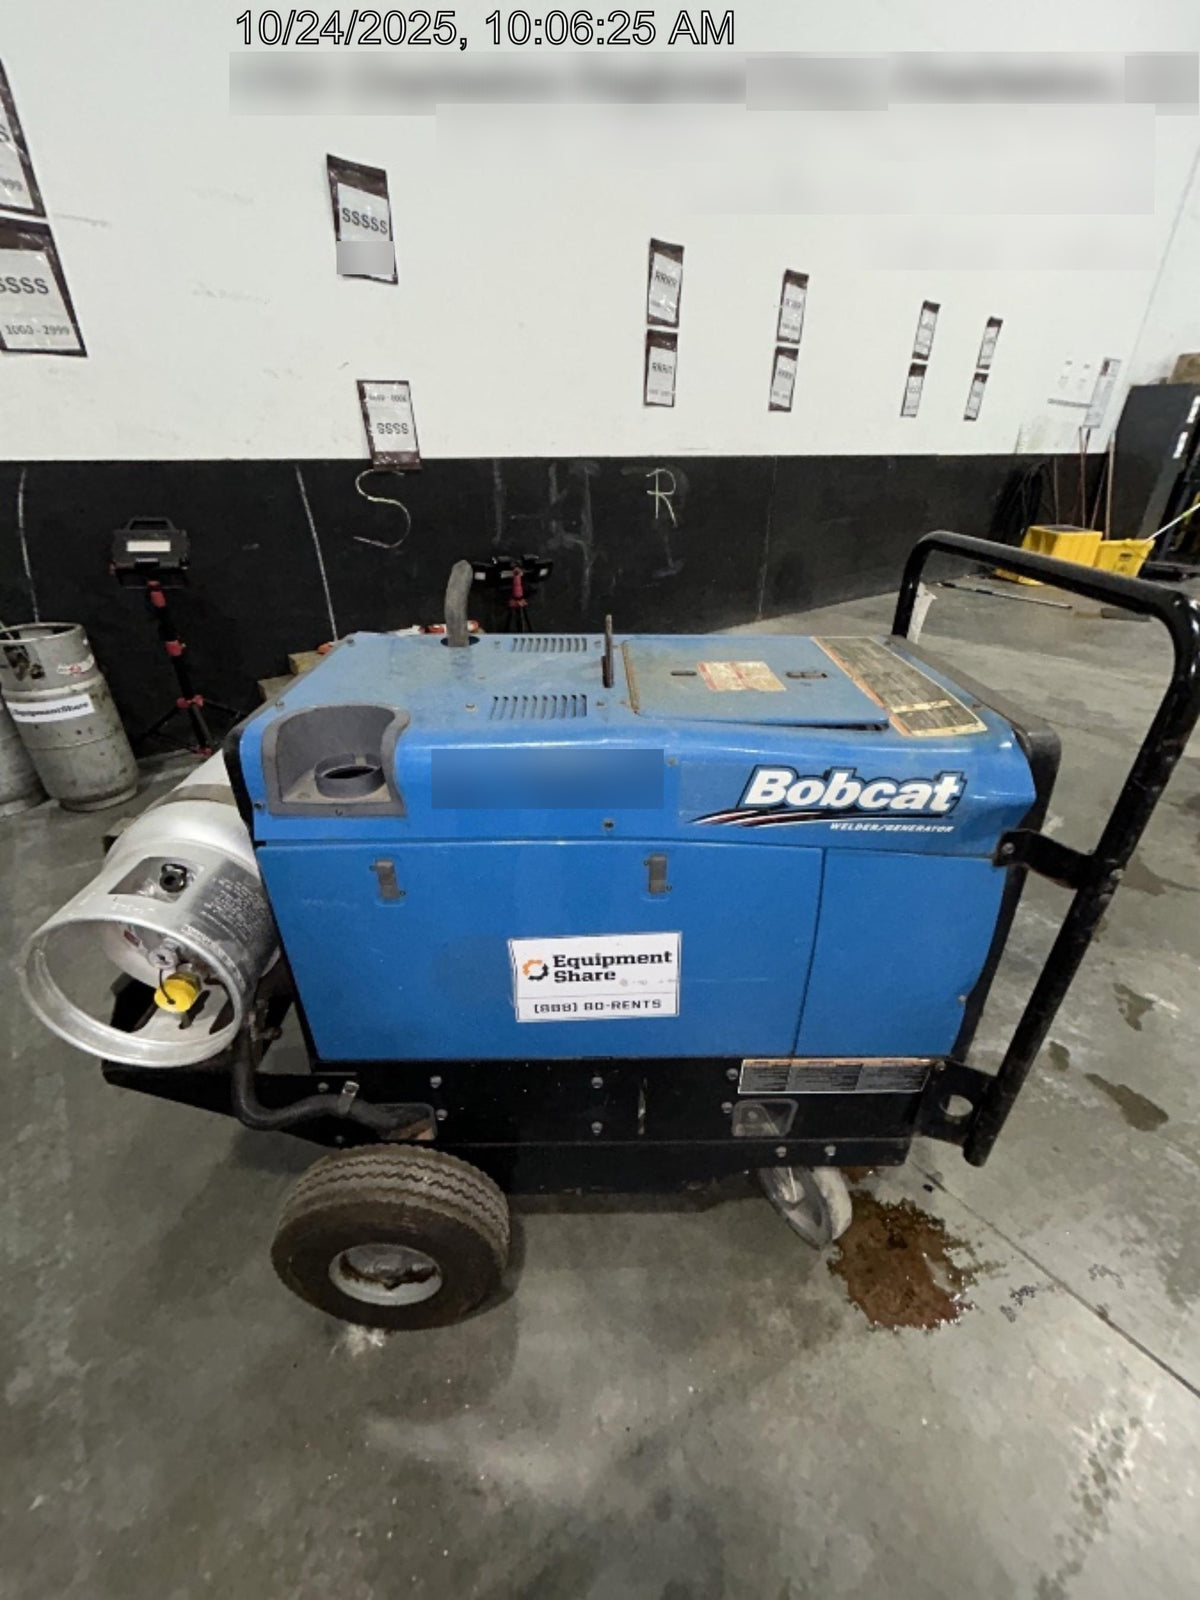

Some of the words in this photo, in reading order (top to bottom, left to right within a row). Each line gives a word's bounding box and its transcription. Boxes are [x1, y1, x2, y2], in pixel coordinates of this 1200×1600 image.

[342, 207, 388, 235] SSSSS
[646, 467, 678, 527] R
[741, 767, 963, 813] Bobcat
[552, 950, 673, 969] Equipment
[553, 970, 617, 983] Share
